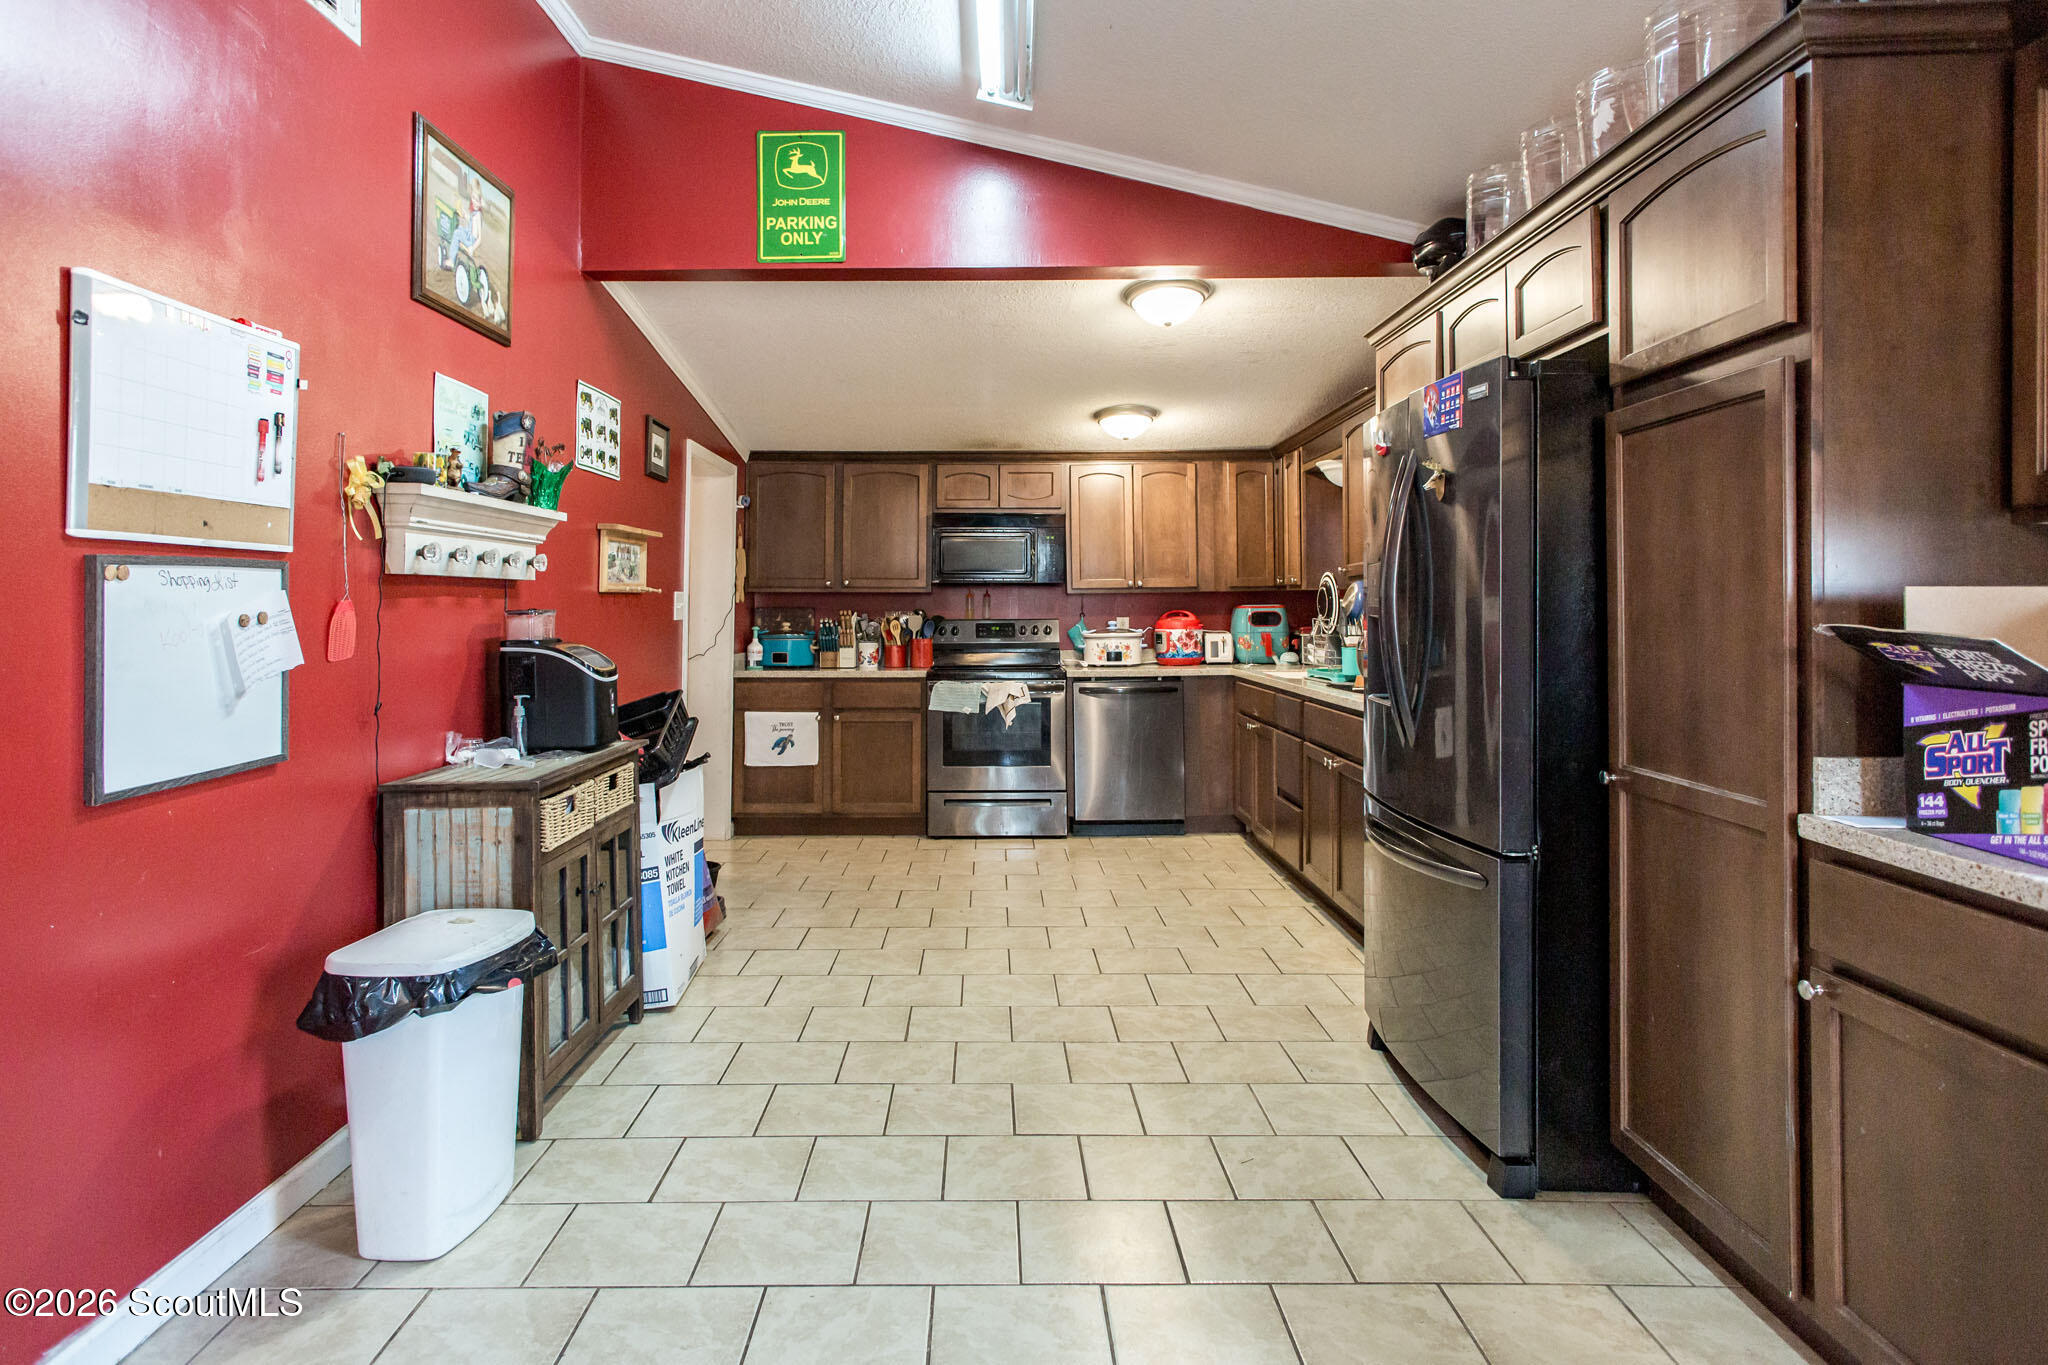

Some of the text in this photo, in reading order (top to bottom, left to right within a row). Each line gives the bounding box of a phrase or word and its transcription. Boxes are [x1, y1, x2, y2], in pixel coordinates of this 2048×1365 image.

[772, 197, 831, 207] JOHN DEERE
[766, 215, 837, 230] PARKING
[780, 231, 823, 246] ONLY
[158, 569, 211, 592] Shopping
[1963, 670, 2014, 684] POPS
[1947, 731, 1987, 753] ALL
[1924, 738, 2010, 779] SPORT
[1944, 778, 1963, 787] BODY
[1919, 795, 1944, 808] 144
[1990, 835, 2003, 844] GET
[2004, 835, 2012, 844] IN
[2014, 835, 2027, 844] THE
[2028, 835, 2041, 845] ALL
[664, 849, 684, 867] WHITE
[641, 869, 658, 880] 085
[666, 861, 690, 882] KITCHEN
[667, 878, 686, 896] TOWEL
